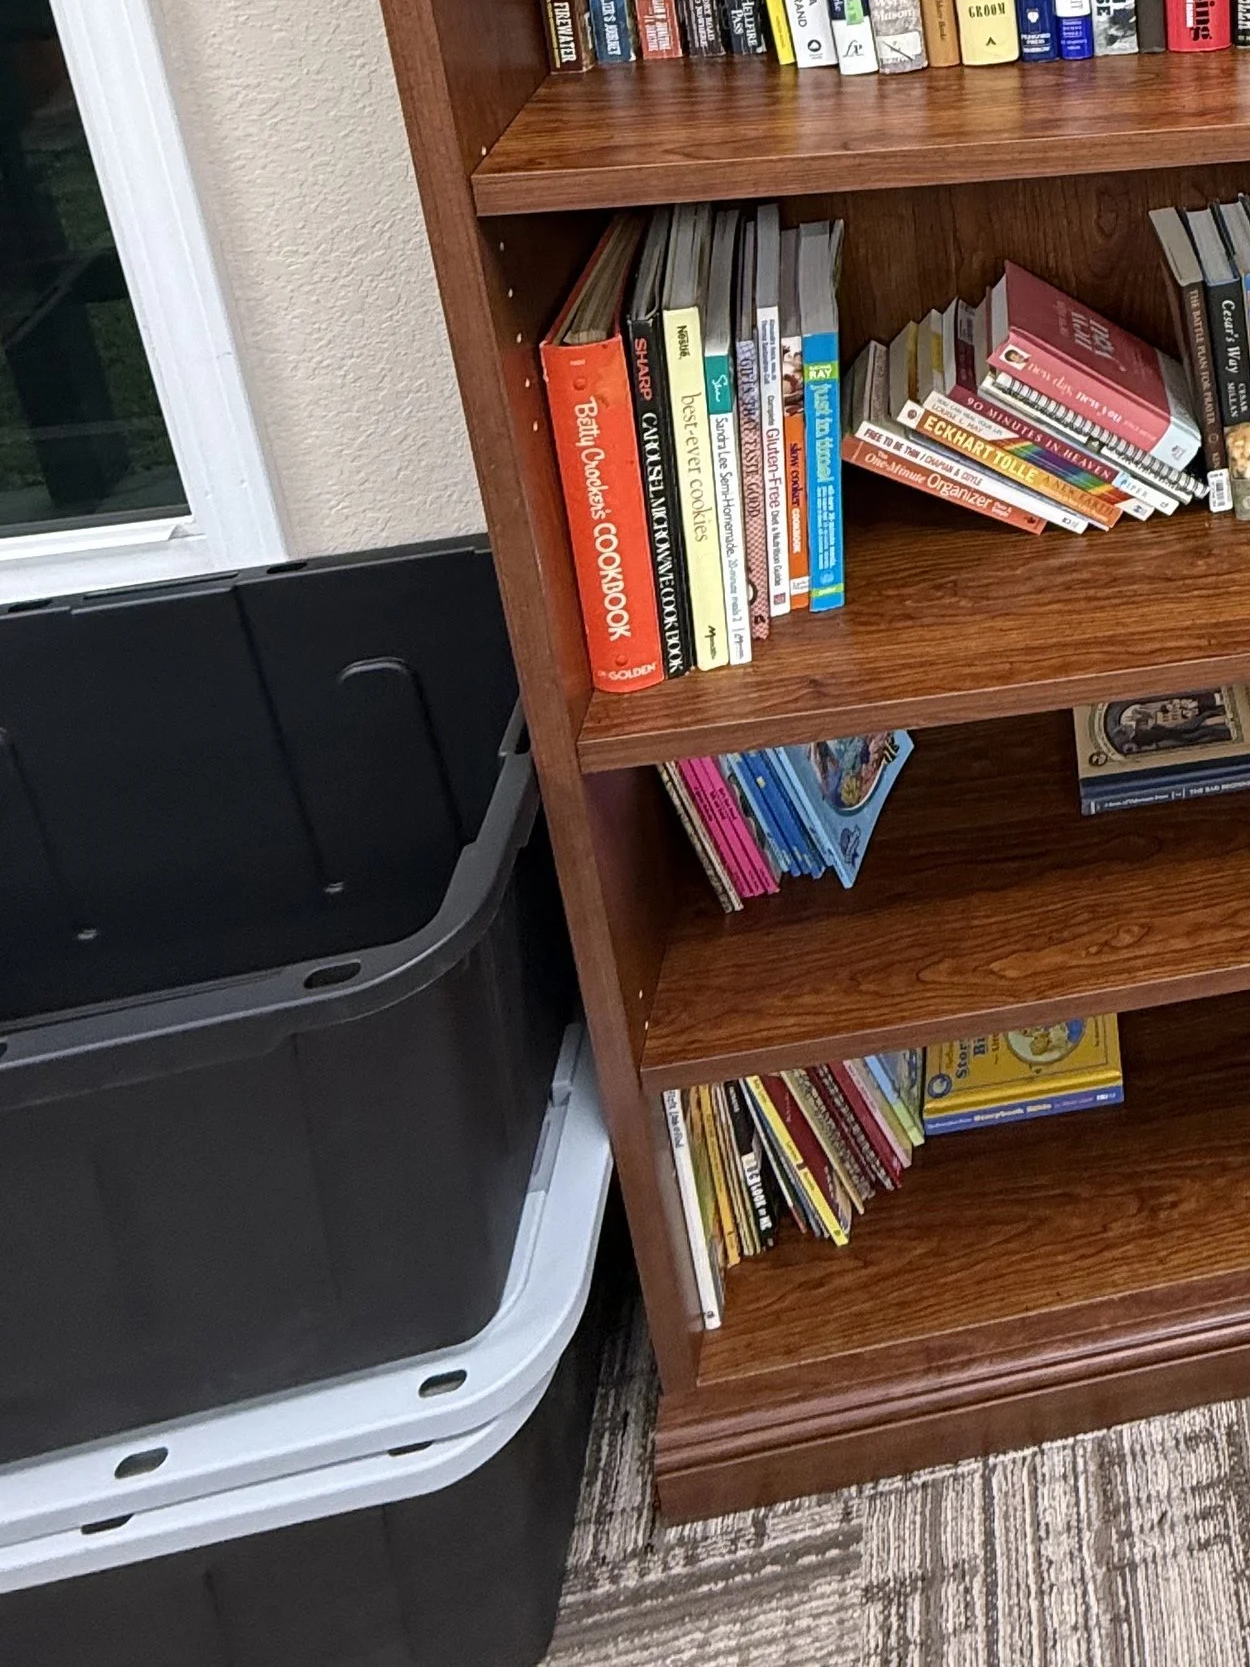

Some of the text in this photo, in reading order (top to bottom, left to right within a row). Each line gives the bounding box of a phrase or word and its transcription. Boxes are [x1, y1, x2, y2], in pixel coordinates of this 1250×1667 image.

[968, 3, 1006, 18] GROOM
[634, 337, 652, 400] SHARP
[1192, 308, 1215, 424] BATTLE PLAN PRAYER
[1222, 299, 1240, 373] Cesar's Way
[1238, 383, 1248, 412] CESAR
[642, 413, 664, 498] CAROUSEL
[681, 392, 712, 542] best-ever cookies
[865, 428, 983, 486] FREE TO BE THIN COYLE
[924, 416, 1038, 484] ECKHART TOLLE
[988, 407, 1111, 480] MINUTES IN HEAVEN
[575, 396, 631, 641] Betty COOKBOOK
[926, 474, 991, 508] Organizer
[1190, 787, 1204, 795] THE
[1205, 784, 1219, 793] BAD
